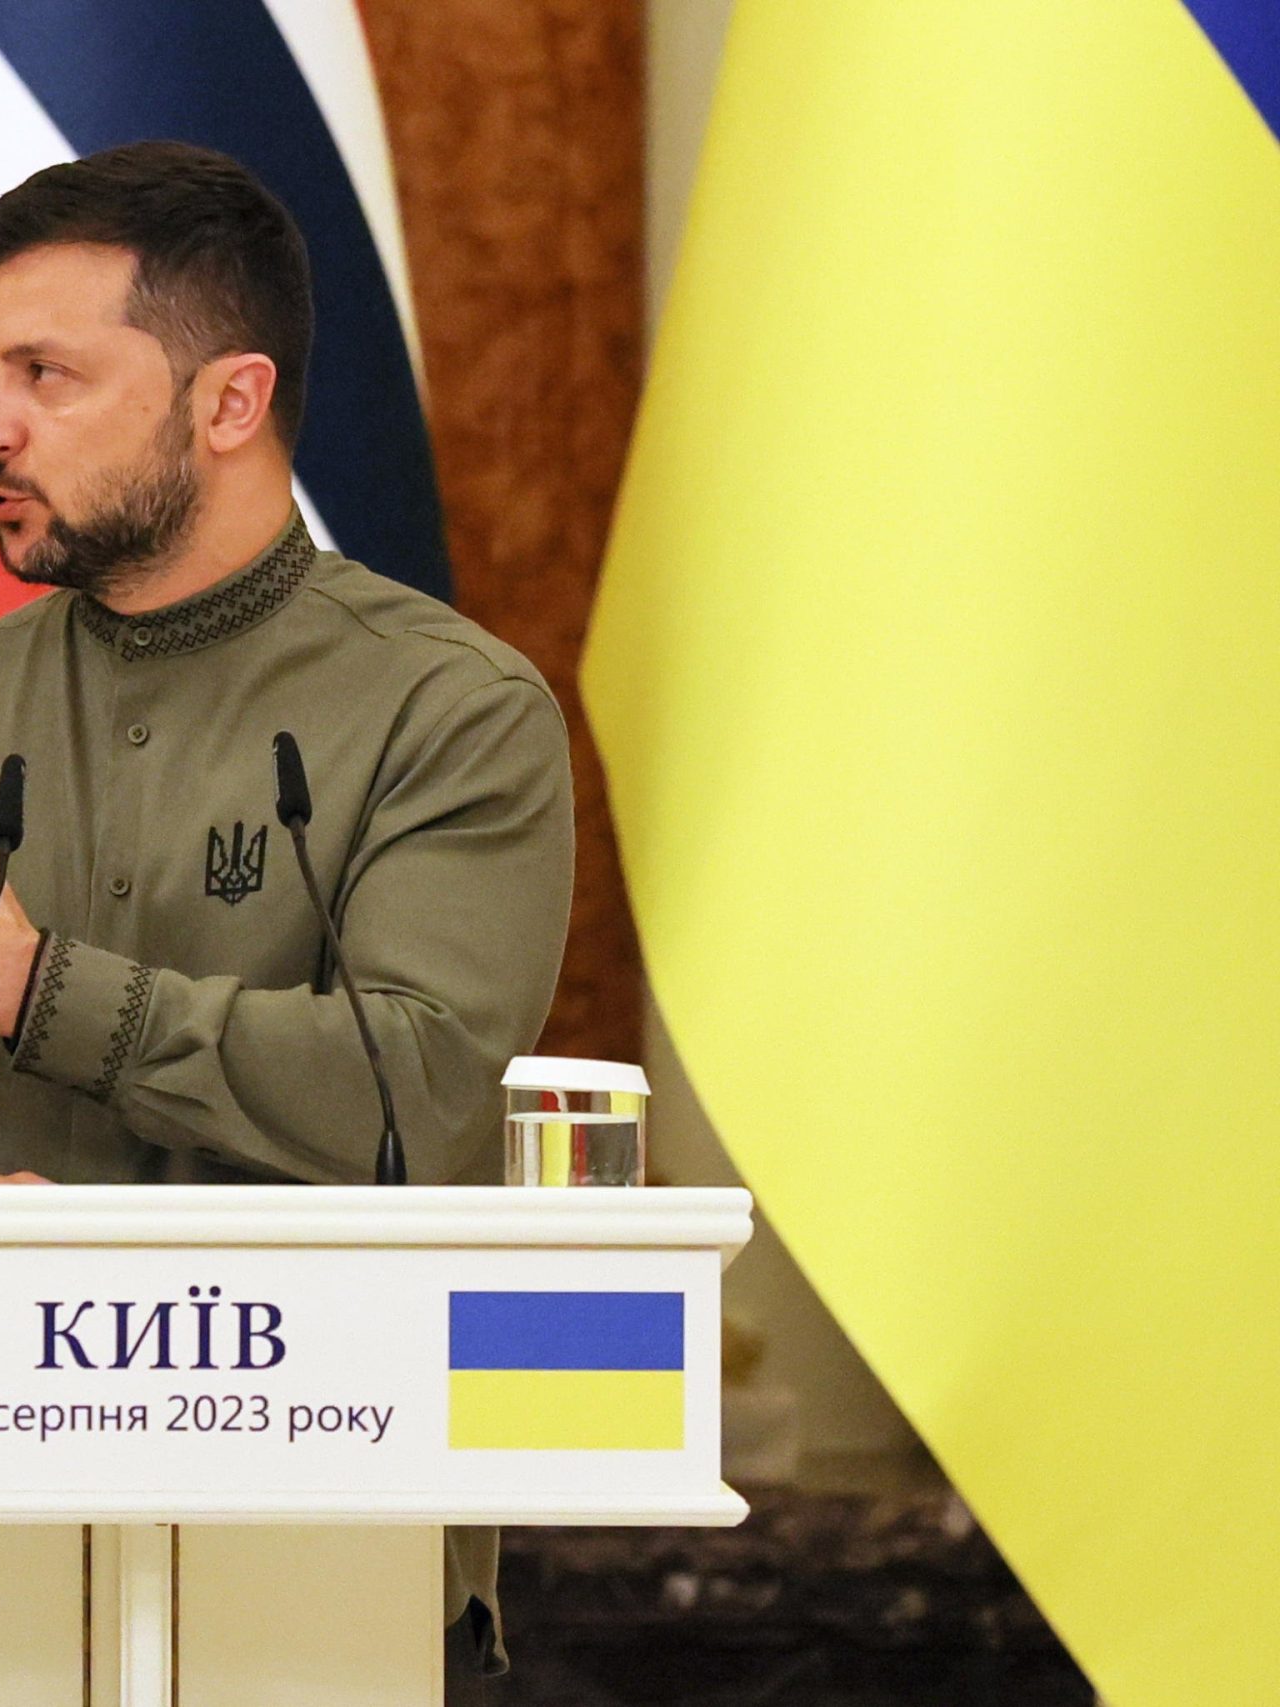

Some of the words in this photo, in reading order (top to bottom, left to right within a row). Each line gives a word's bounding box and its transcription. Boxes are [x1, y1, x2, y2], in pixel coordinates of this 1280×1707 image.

[34, 1284, 287, 1370] КИЇВ
[165, 1394, 271, 1432] 2023
[288, 1404, 395, 1444] року
